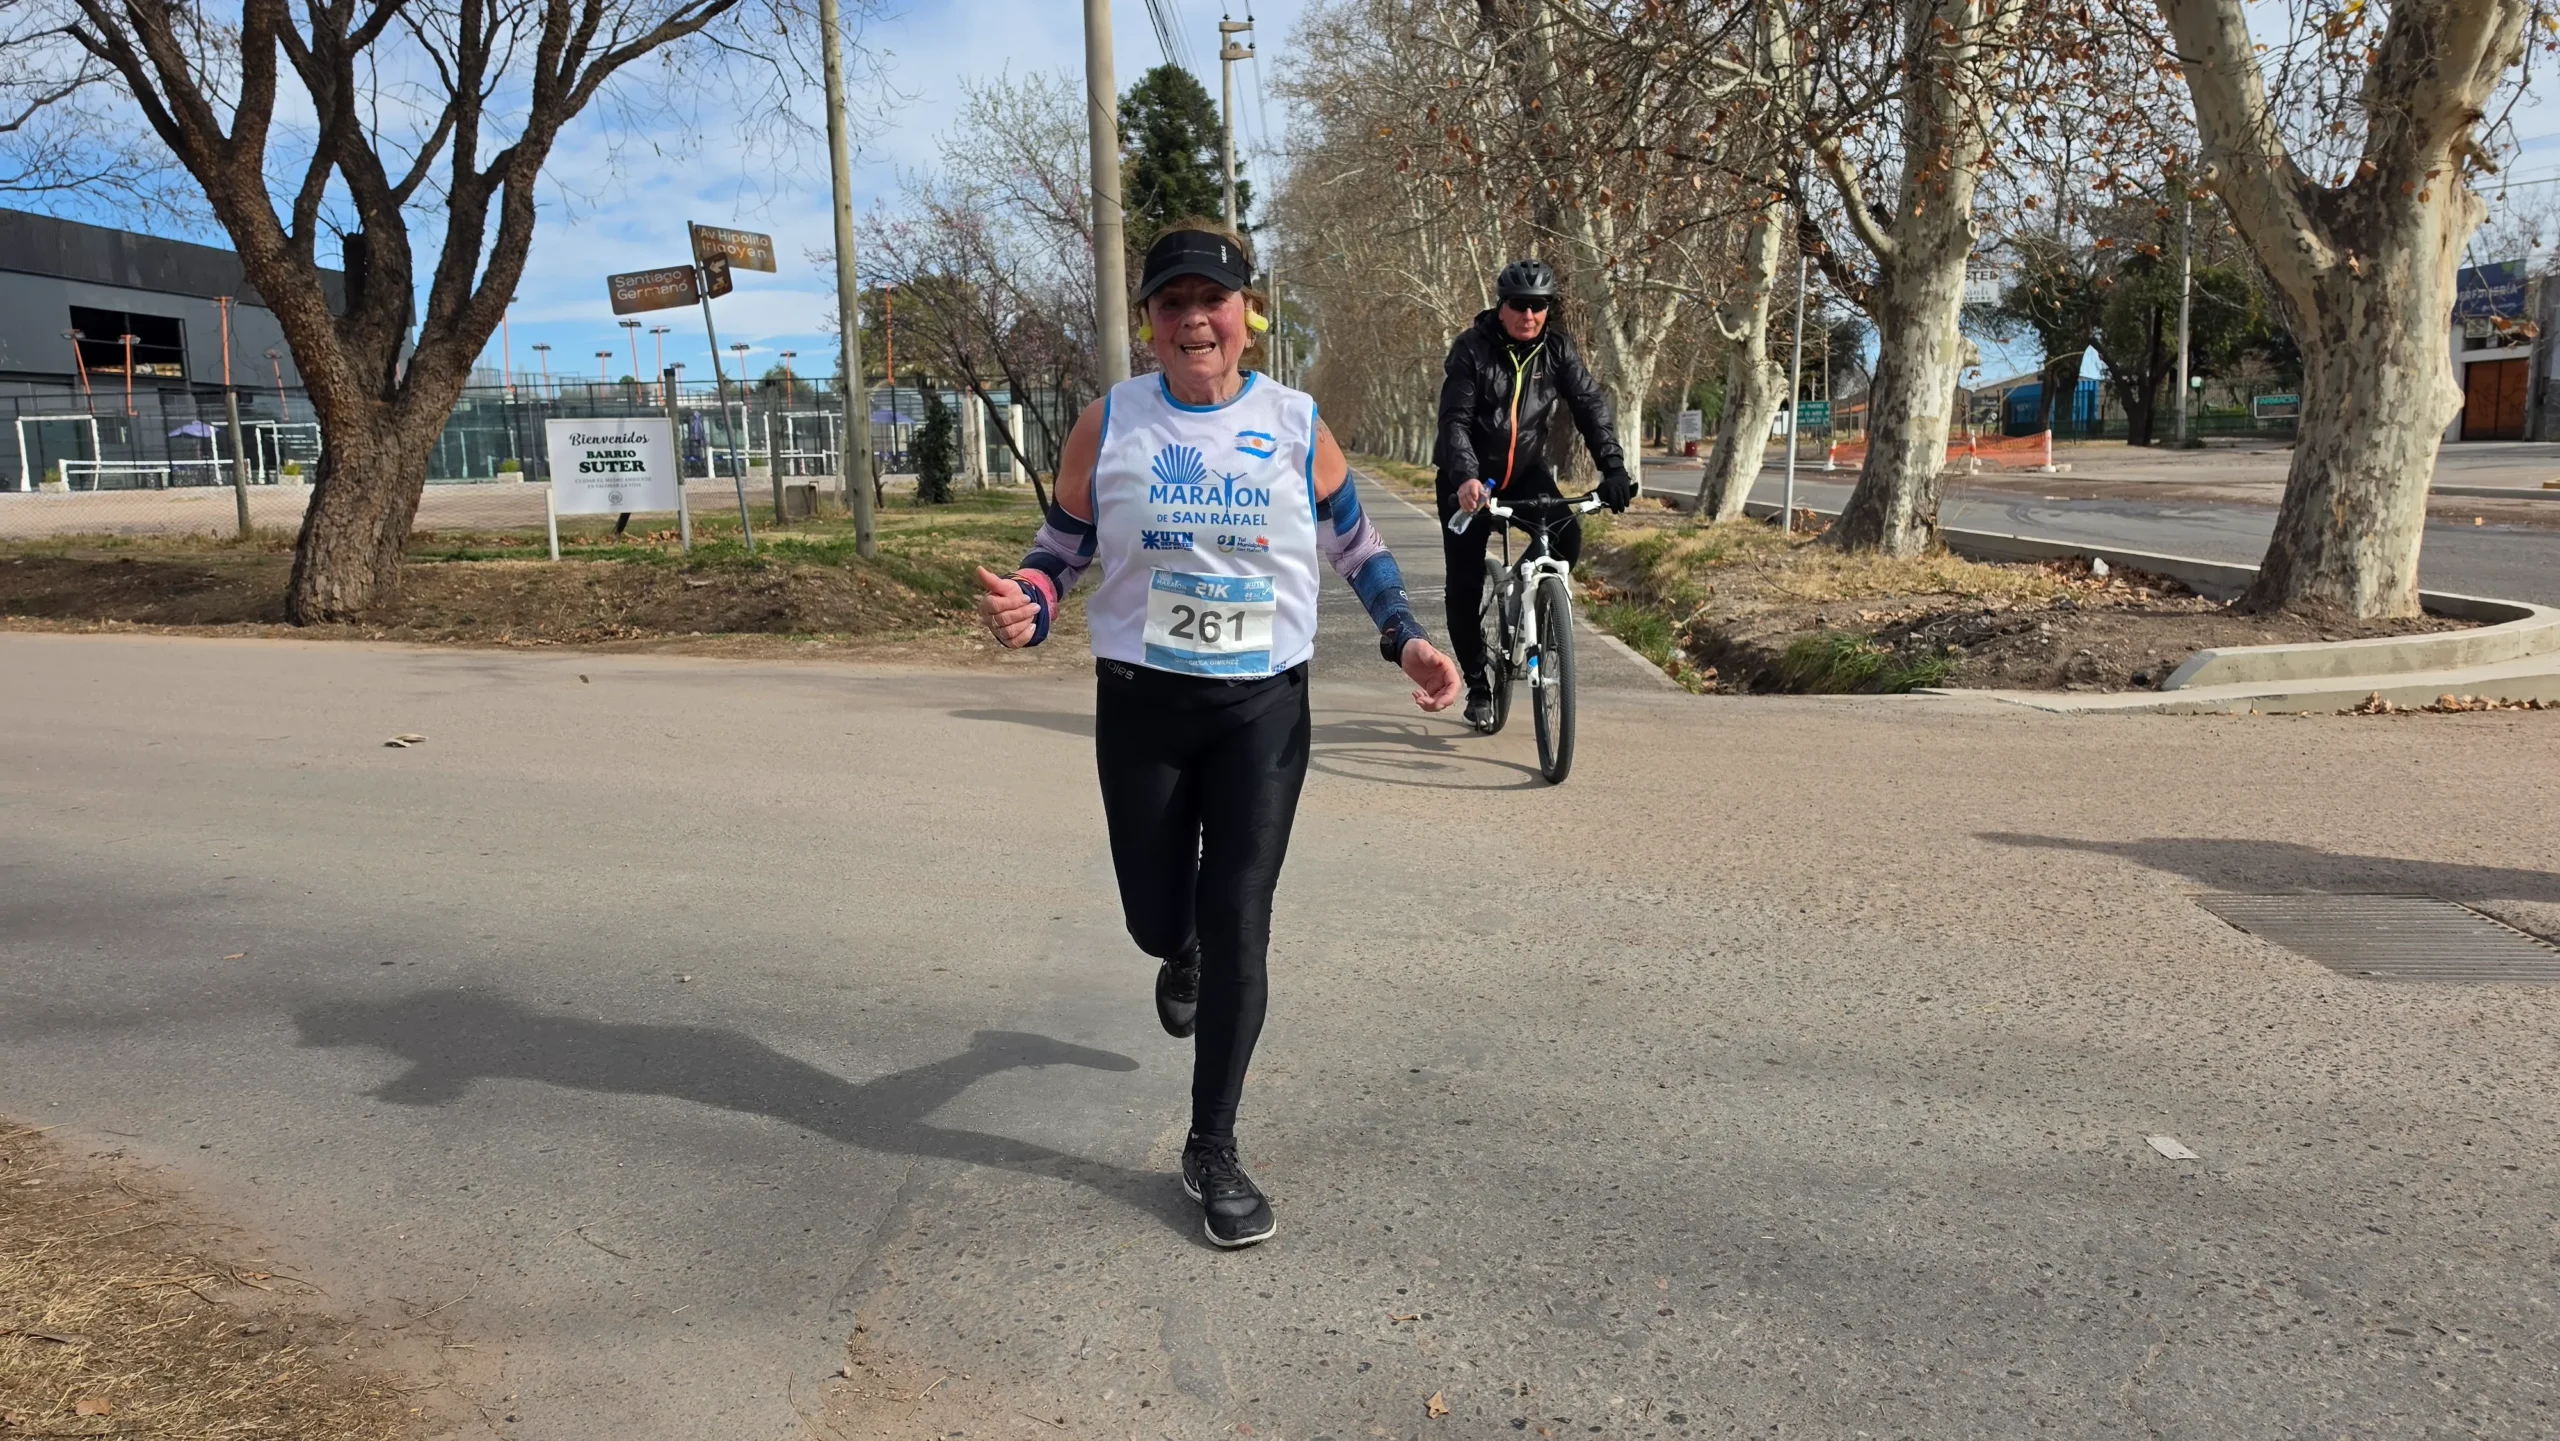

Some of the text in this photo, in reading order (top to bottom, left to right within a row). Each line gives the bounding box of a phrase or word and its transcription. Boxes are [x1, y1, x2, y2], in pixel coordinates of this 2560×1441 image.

[701, 227, 715, 239] Av
[614, 270, 682, 288] Santiago
[617, 279, 688, 300] Germanó
[569, 431, 651, 446] Bienvenidos
[586, 450, 637, 459] BARRIO
[579, 460, 646, 473] SUTER
[1157, 511, 1268, 526] DE SAN RAFAEL
[1160, 531, 1194, 543] UTN
[1195, 581, 1231, 598] 21K
[1168, 604, 1246, 643] 261
